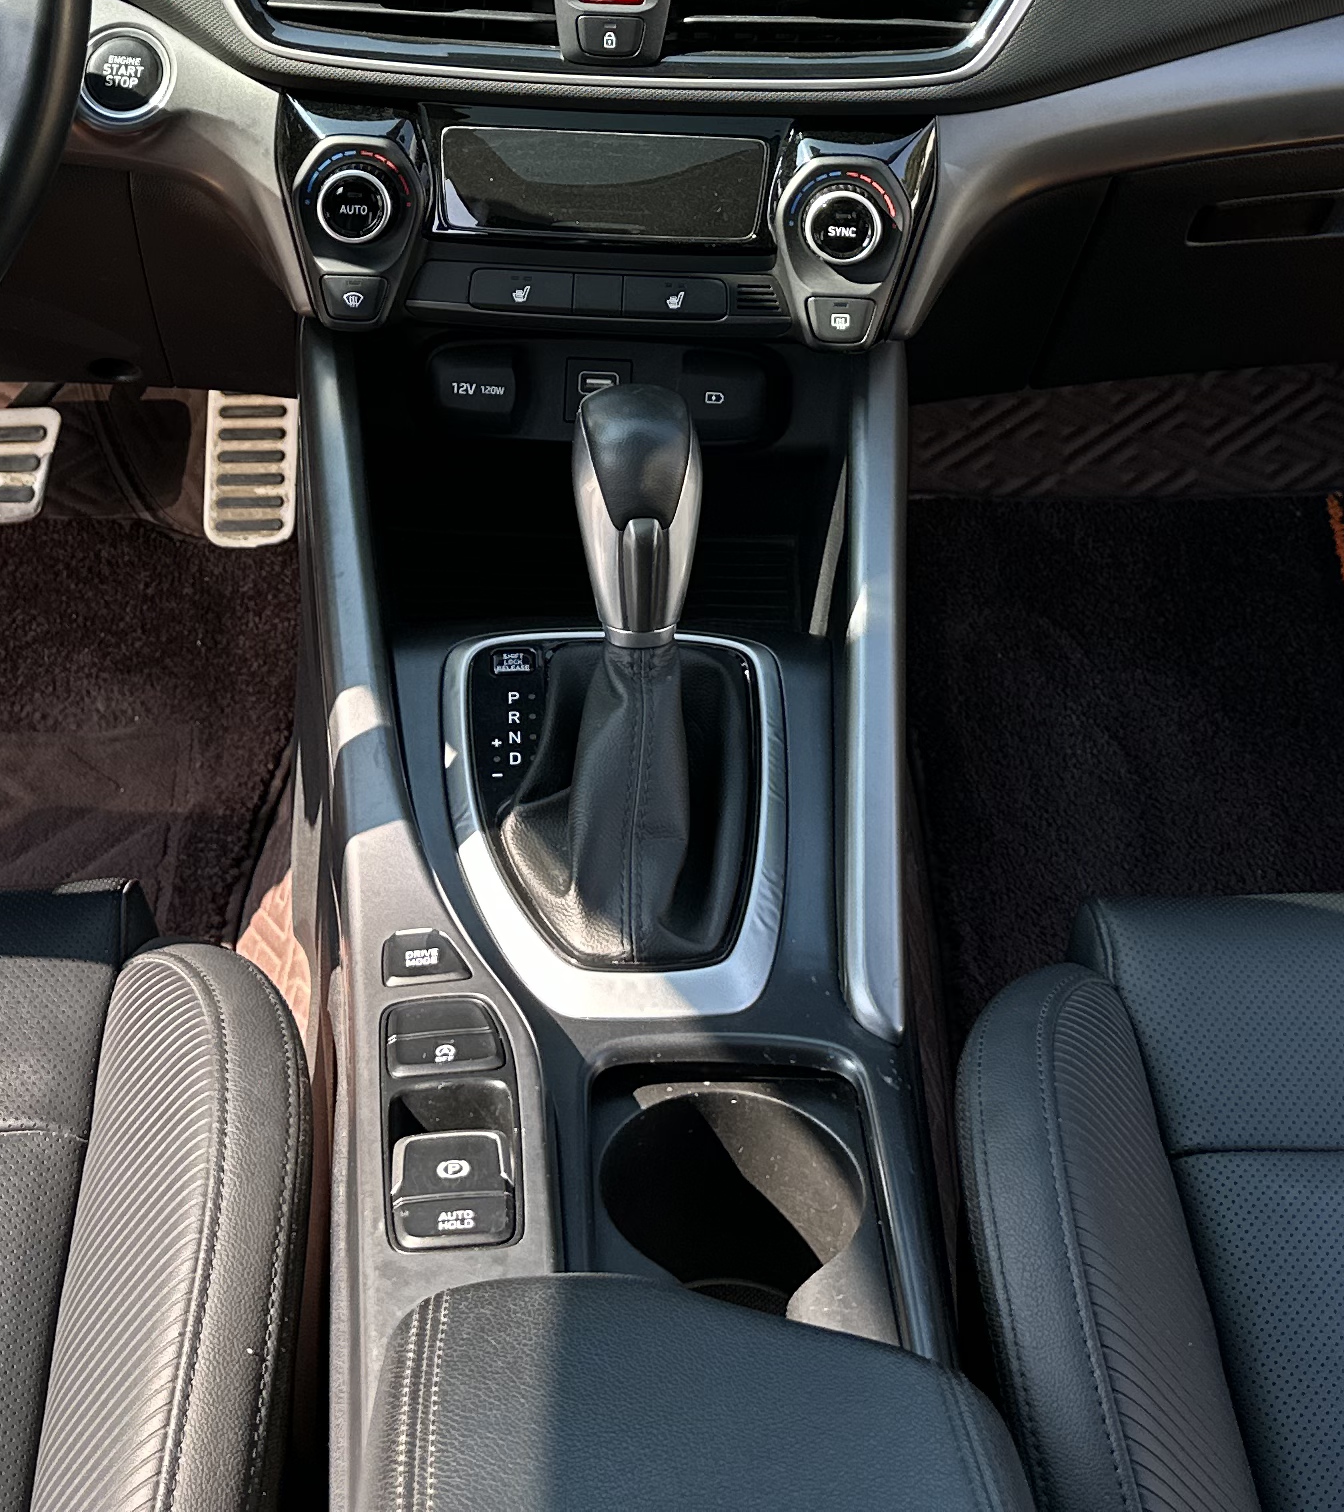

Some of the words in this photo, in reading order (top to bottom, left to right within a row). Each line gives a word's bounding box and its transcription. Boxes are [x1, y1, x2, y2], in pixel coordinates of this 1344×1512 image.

[107, 55, 142, 66] ENGINE
[102, 63, 145, 78] START
[104, 74, 139, 89] STOP
[339, 204, 368, 215] AUTO
[827, 226, 857, 238] SYNC
[451, 382, 477, 396] 12V
[479, 385, 506, 396] 120W
[508, 691, 520, 704] P
[508, 711, 521, 724] R
[508, 731, 522, 744] N
[509, 752, 522, 765] D
[405, 948, 439, 959] DRIVE
[437, 1209, 475, 1221] AUTO
[437, 1219, 476, 1231] HOLD
